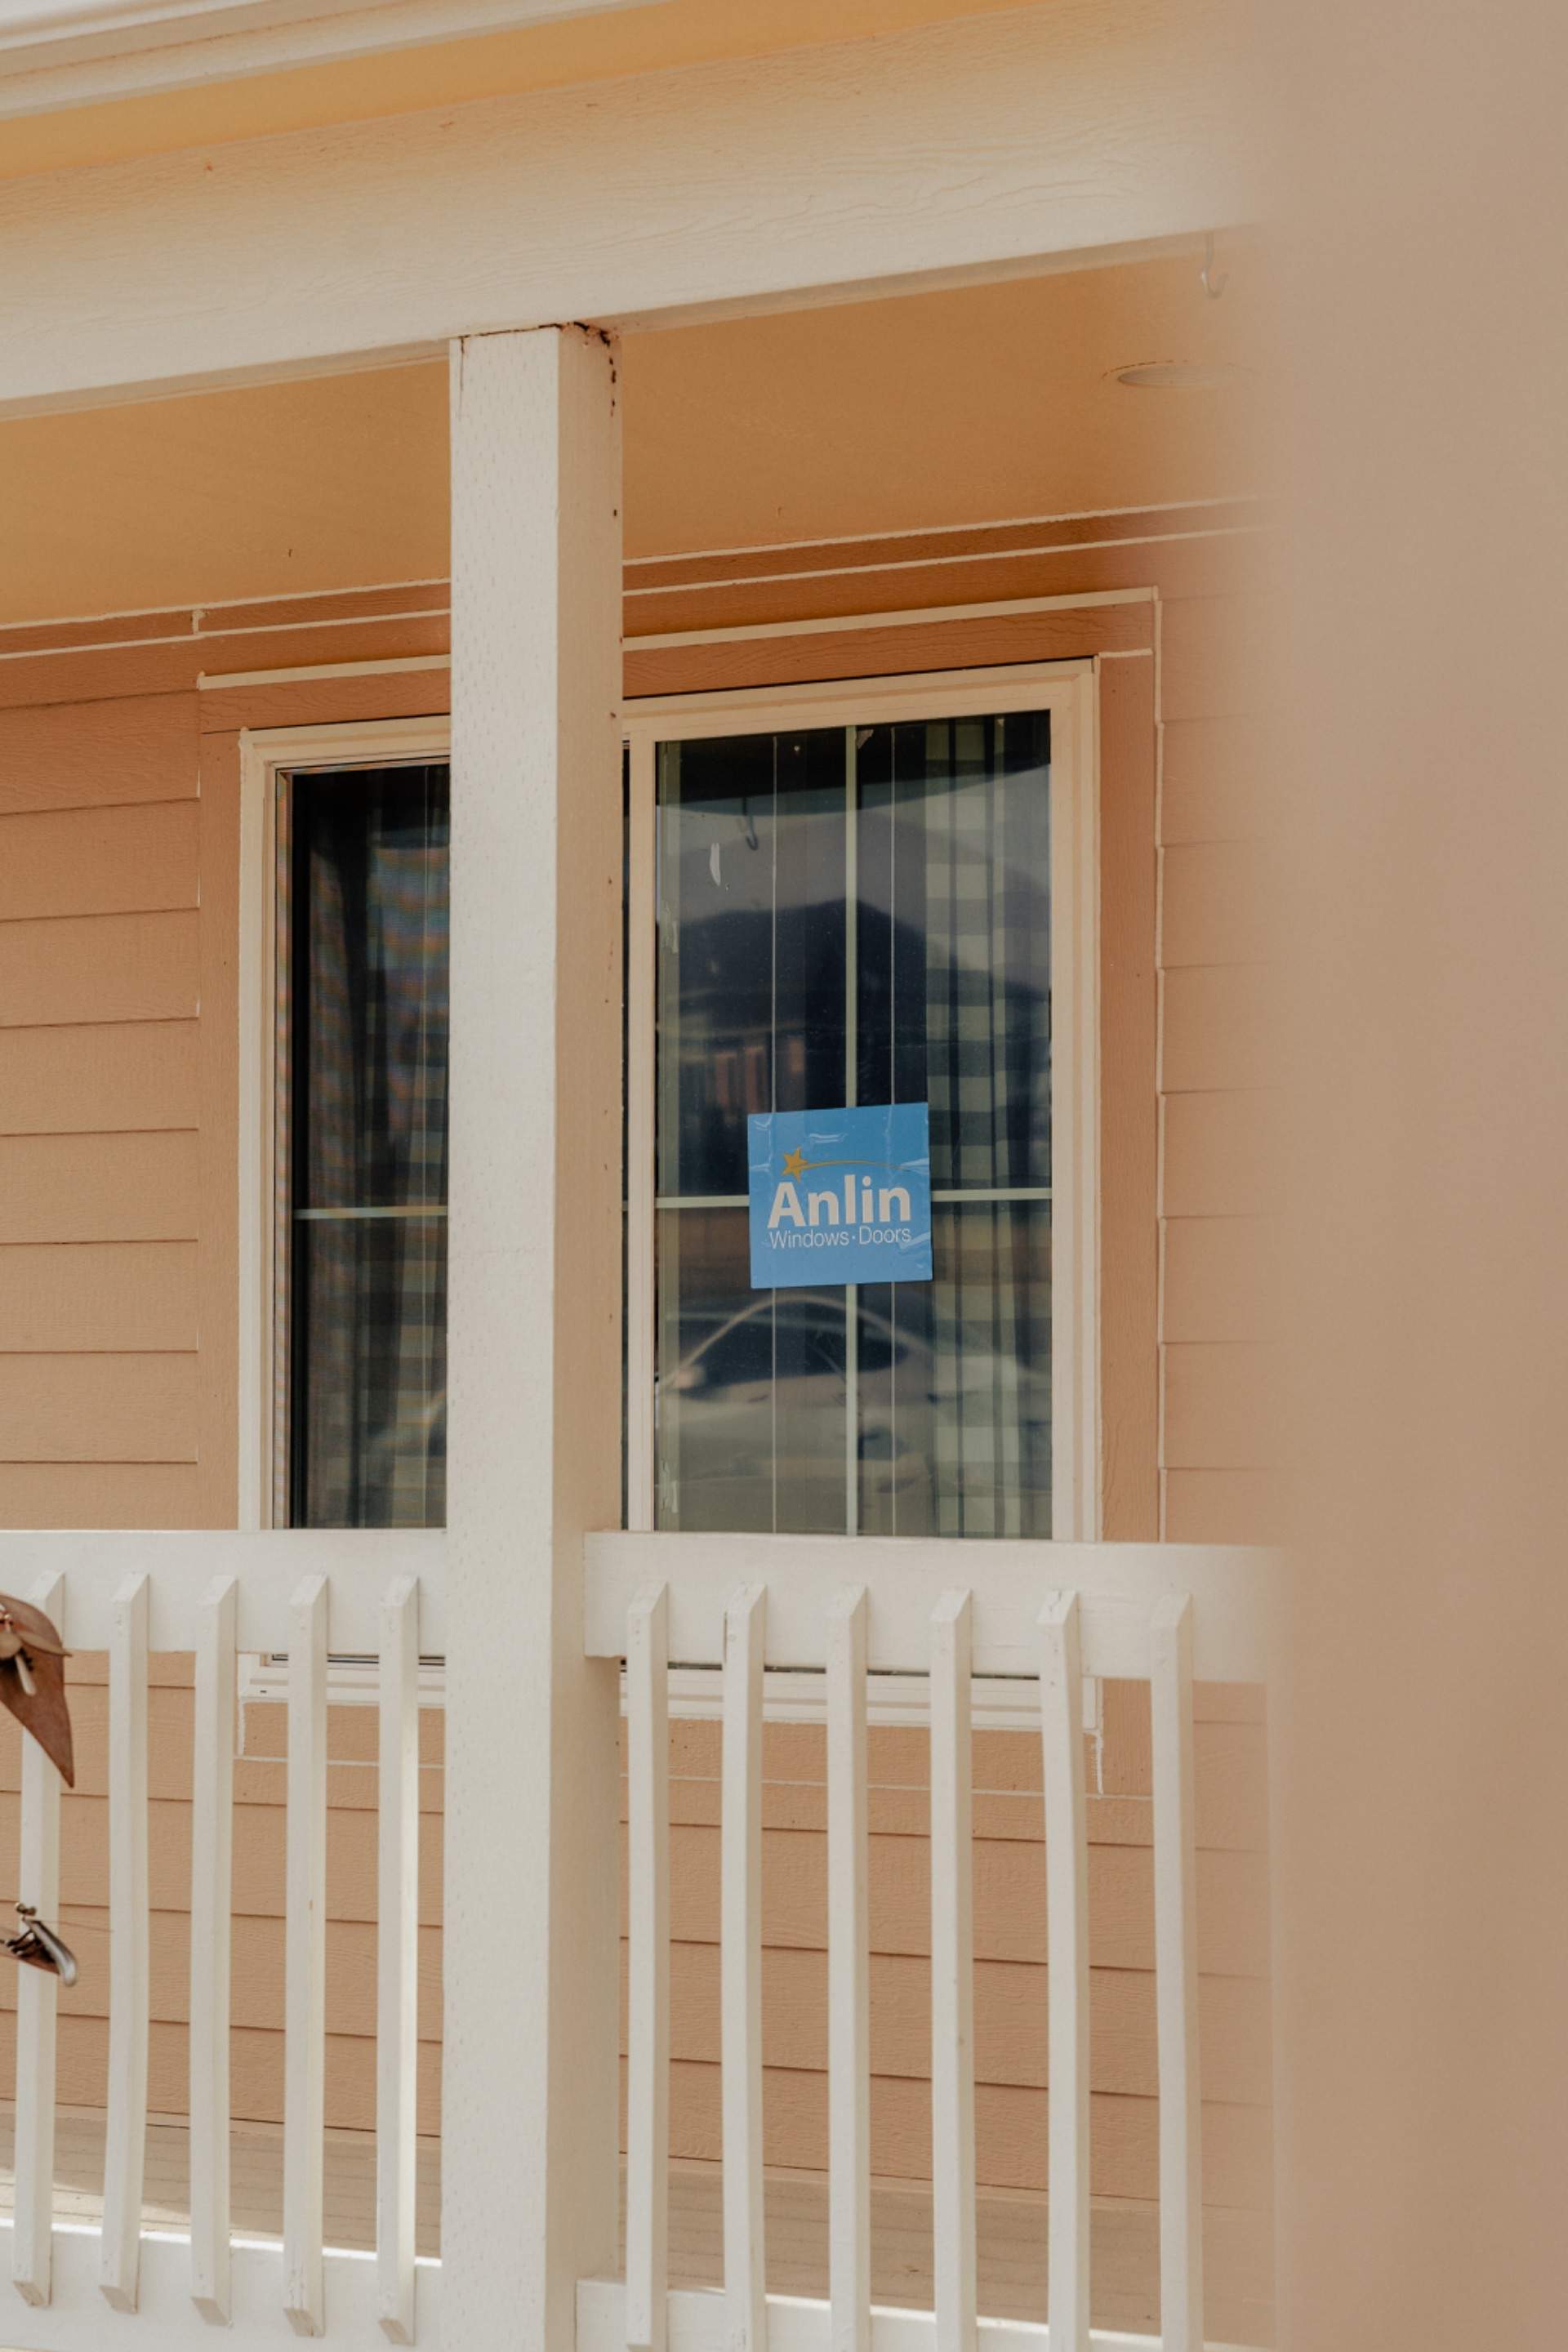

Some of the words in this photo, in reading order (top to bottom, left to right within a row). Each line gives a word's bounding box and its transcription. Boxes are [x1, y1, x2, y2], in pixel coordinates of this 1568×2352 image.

[768, 1174, 911, 1228] Anlin
[769, 1228, 850, 1249] Windows
[858, 1226, 911, 1245] Doors
